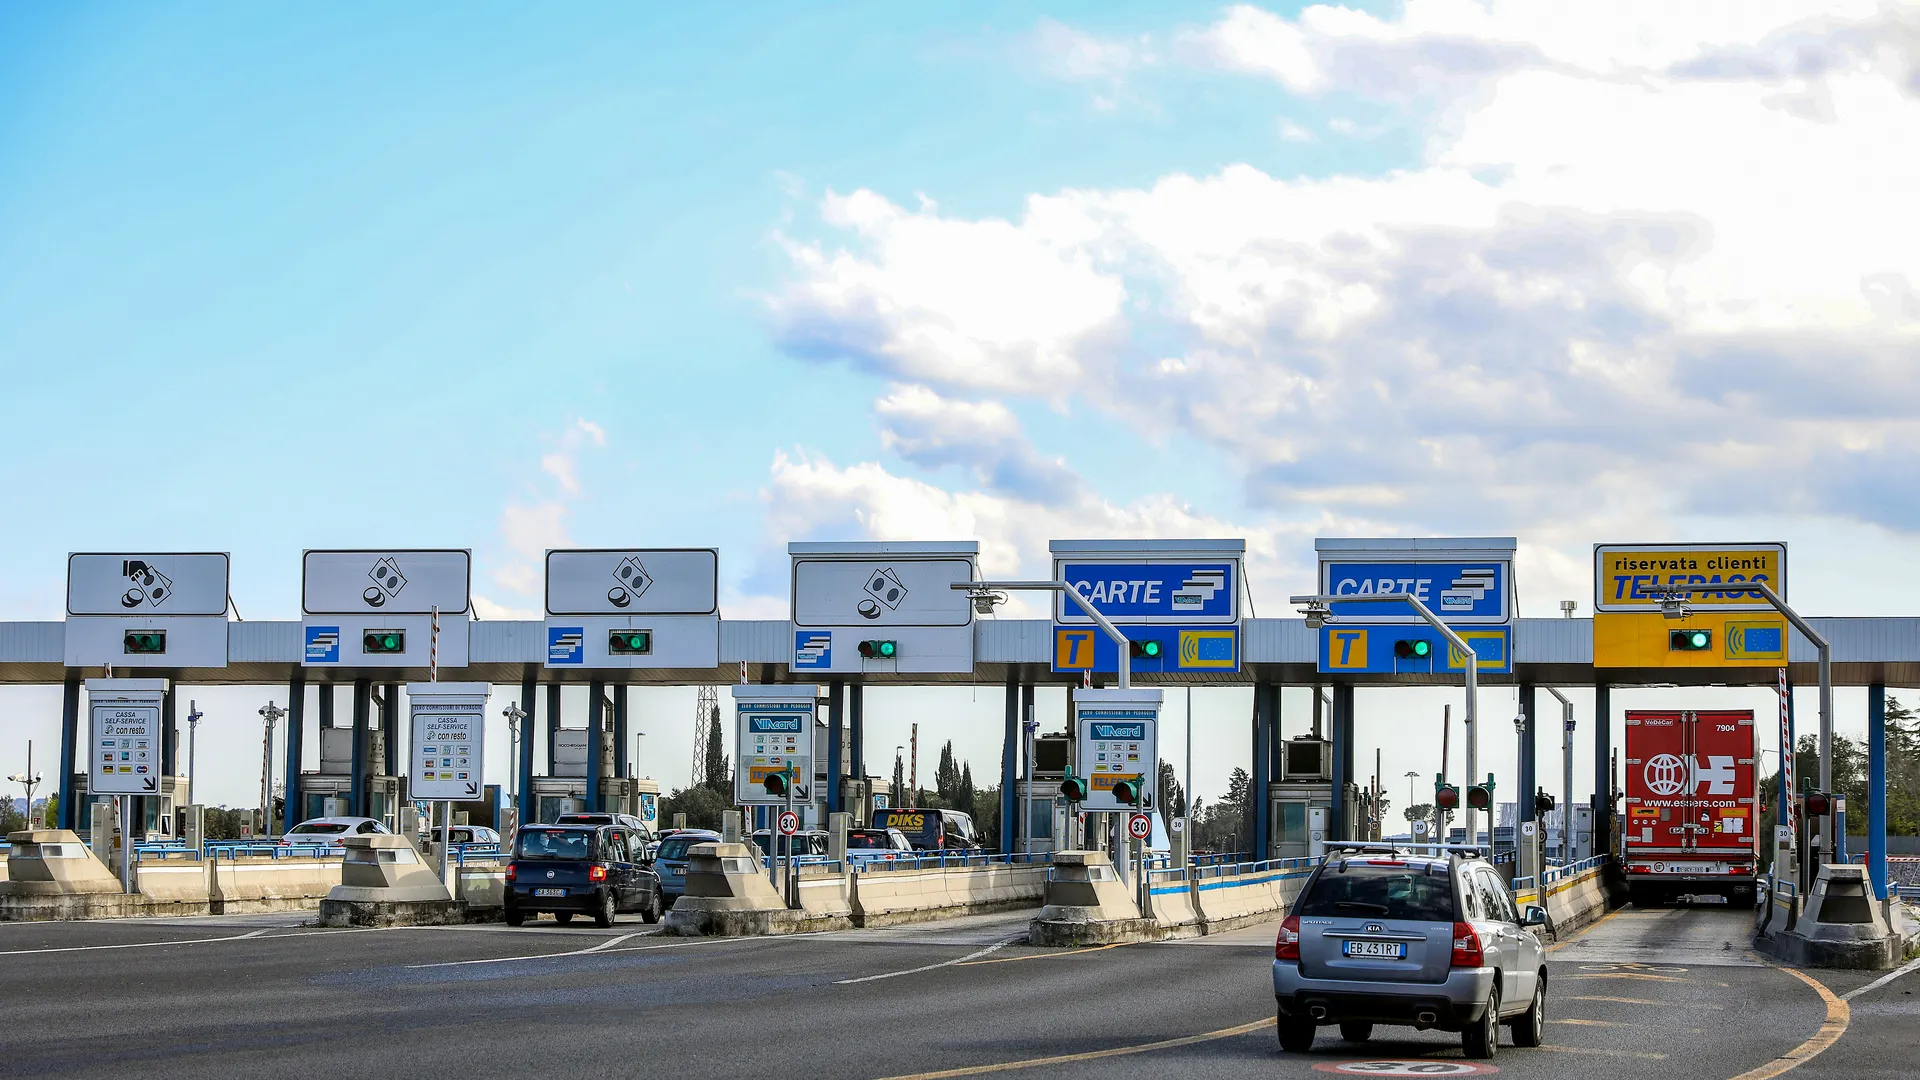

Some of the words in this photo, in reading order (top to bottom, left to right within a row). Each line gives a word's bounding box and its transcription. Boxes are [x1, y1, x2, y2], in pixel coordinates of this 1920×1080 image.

[1615, 557, 1698, 570] riservata
[1707, 556, 1766, 570] clienti
[1072, 580, 1163, 604] CARTE
[1336, 578, 1432, 602] CARTE
[1613, 574, 1769, 599] TELEPASS
[1065, 634, 1088, 665] T
[1336, 633, 1360, 665] T
[129, 726, 145, 735] resto
[1716, 724, 1736, 732] 7904
[450, 732, 467, 740] resto
[1643, 800, 1736, 808] www.essers.com
[782, 818, 795, 829] 30
[886, 814, 925, 827] DIKS
[1133, 821, 1147, 832] 30
[1350, 942, 1363, 953] EB
[1366, 943, 1399, 955] 431RT
